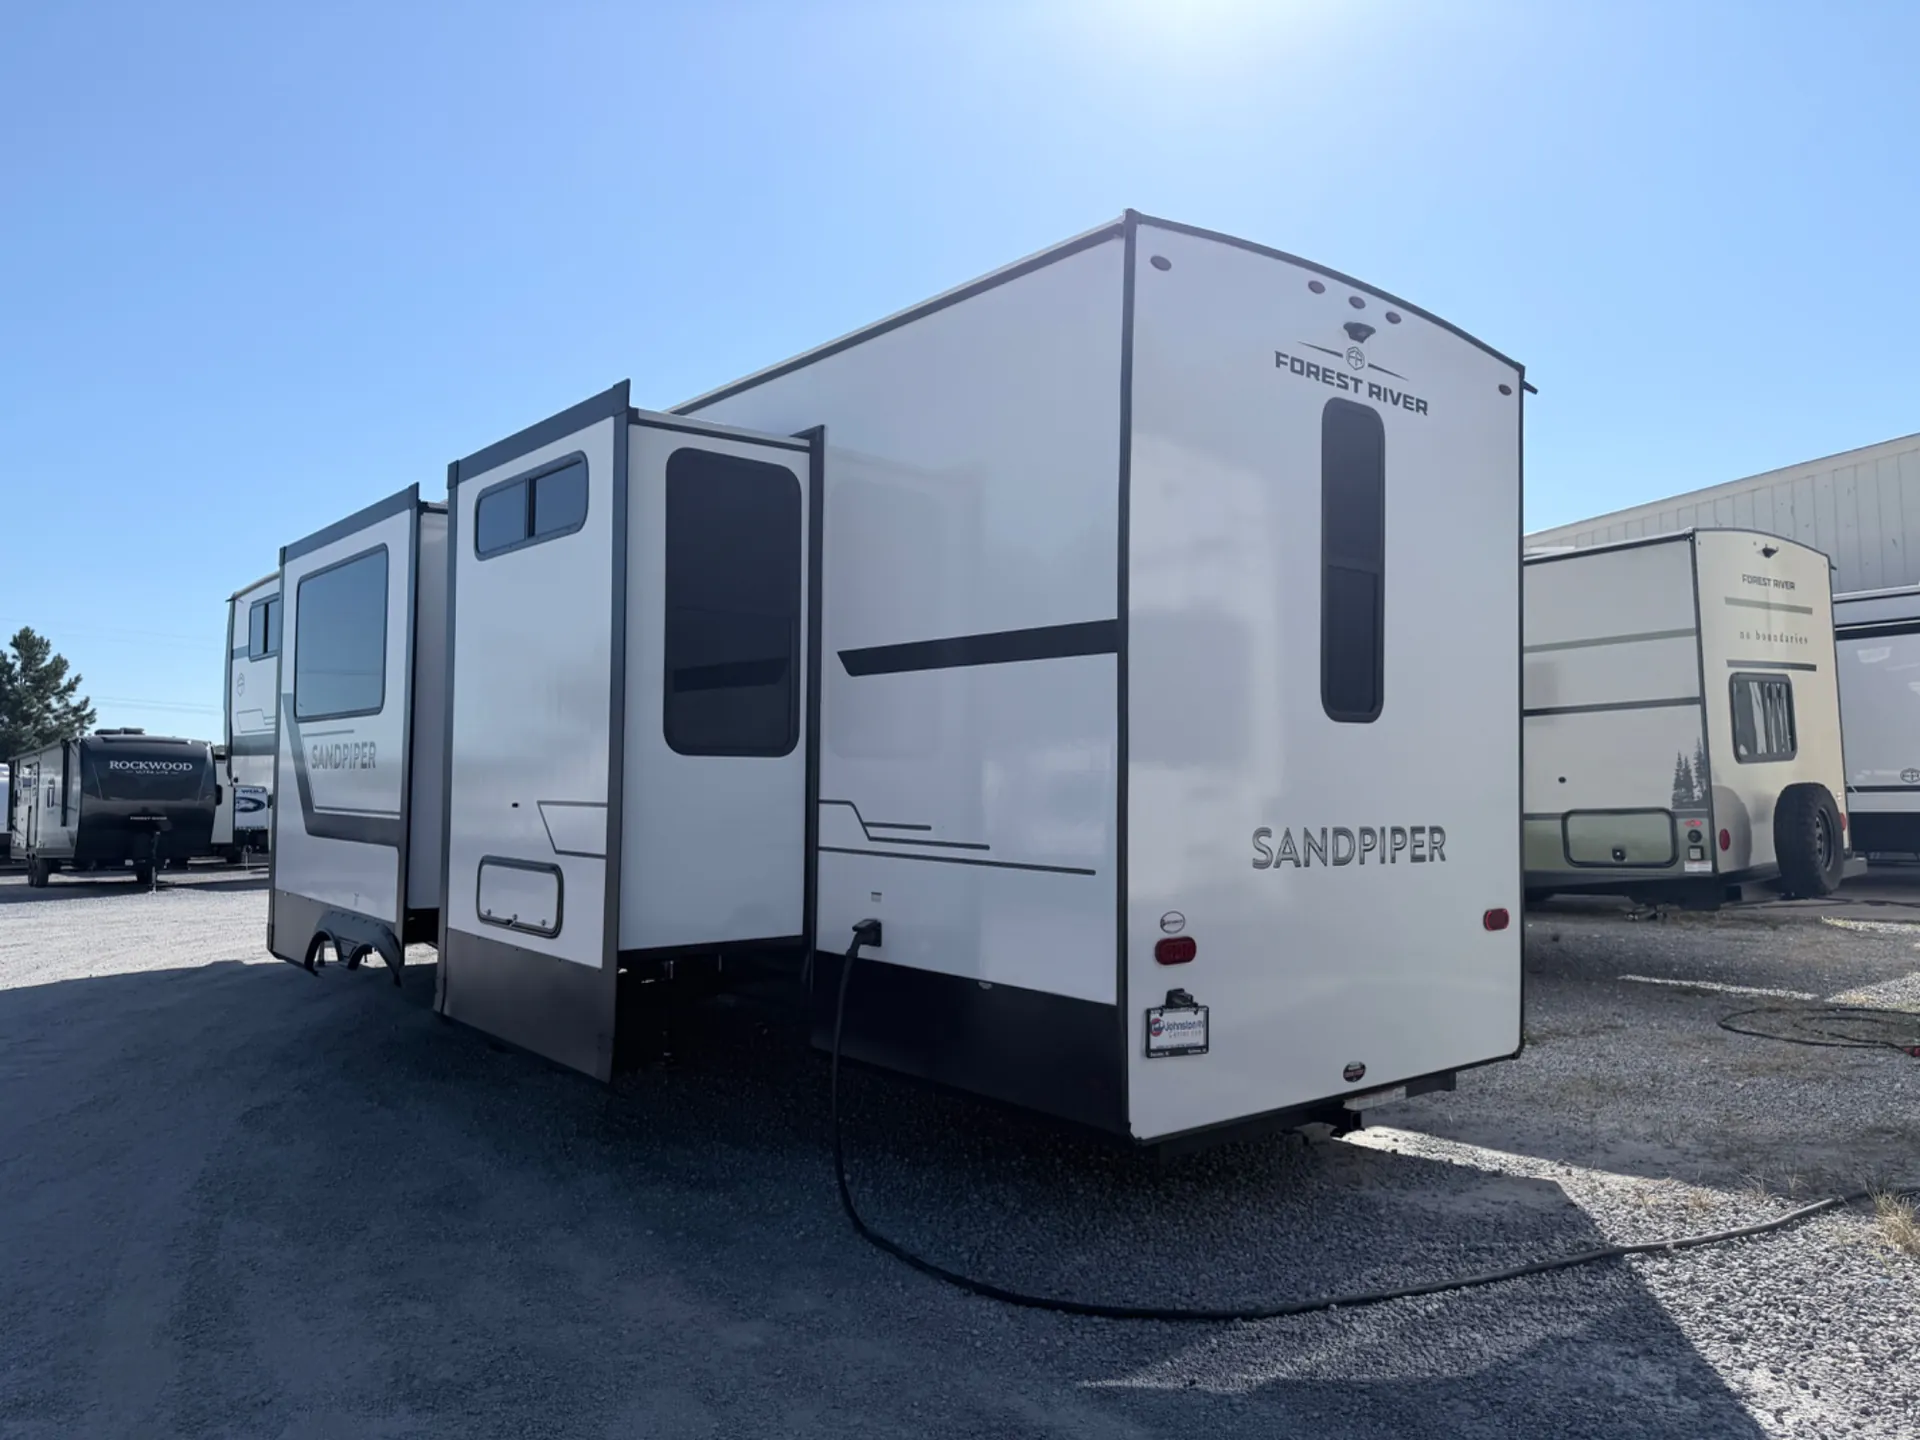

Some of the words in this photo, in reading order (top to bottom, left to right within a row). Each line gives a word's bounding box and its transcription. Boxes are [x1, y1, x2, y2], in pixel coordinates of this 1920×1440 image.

[1275, 351, 1363, 393] FOREST
[1368, 381, 1428, 416] RIVER
[1742, 573, 1772, 587] FOREST
[1773, 579, 1796, 591] RIVER
[1756, 630, 1808, 645] boundaries
[109, 760, 193, 771] ROCKWOOD
[312, 741, 376, 769] SANDPIPER
[1252, 825, 1446, 870] SANDPIPER
